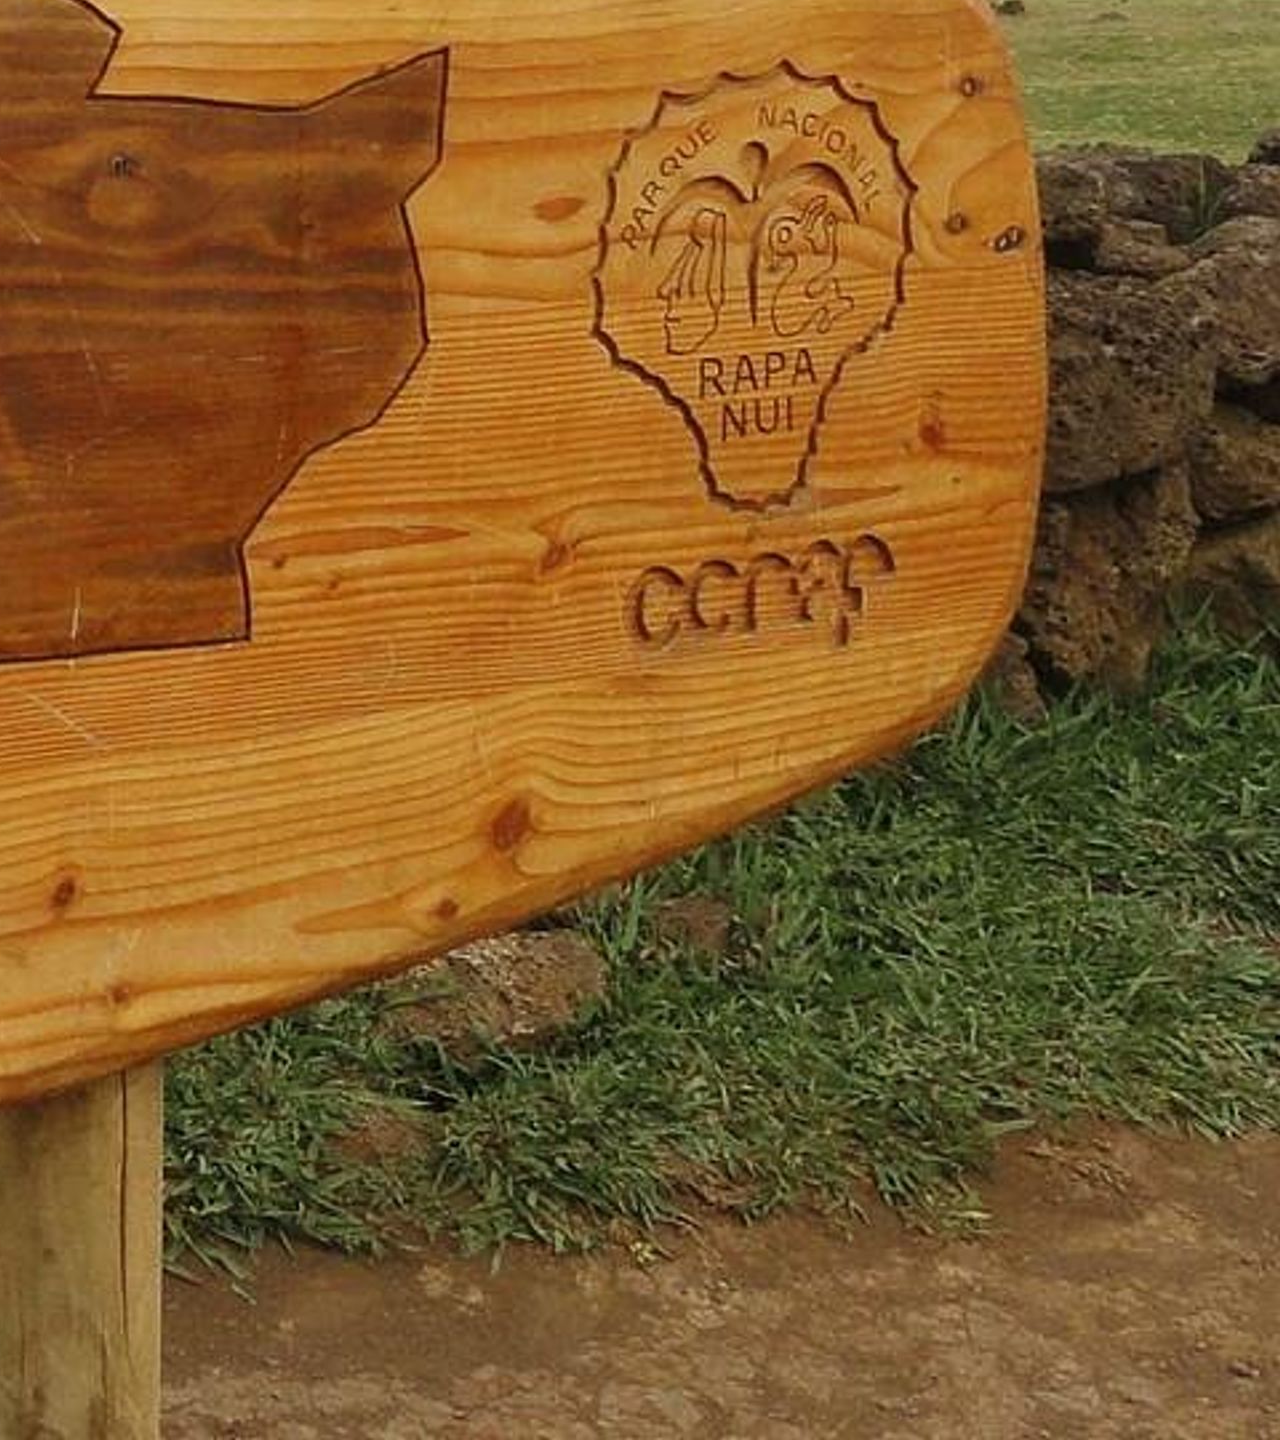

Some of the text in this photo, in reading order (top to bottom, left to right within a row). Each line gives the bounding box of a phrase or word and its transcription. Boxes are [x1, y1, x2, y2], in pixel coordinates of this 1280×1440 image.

[621, 105, 880, 250] PARQUE NACIONAL
[698, 349, 817, 398] RAPA
[721, 398, 794, 441] NUI
